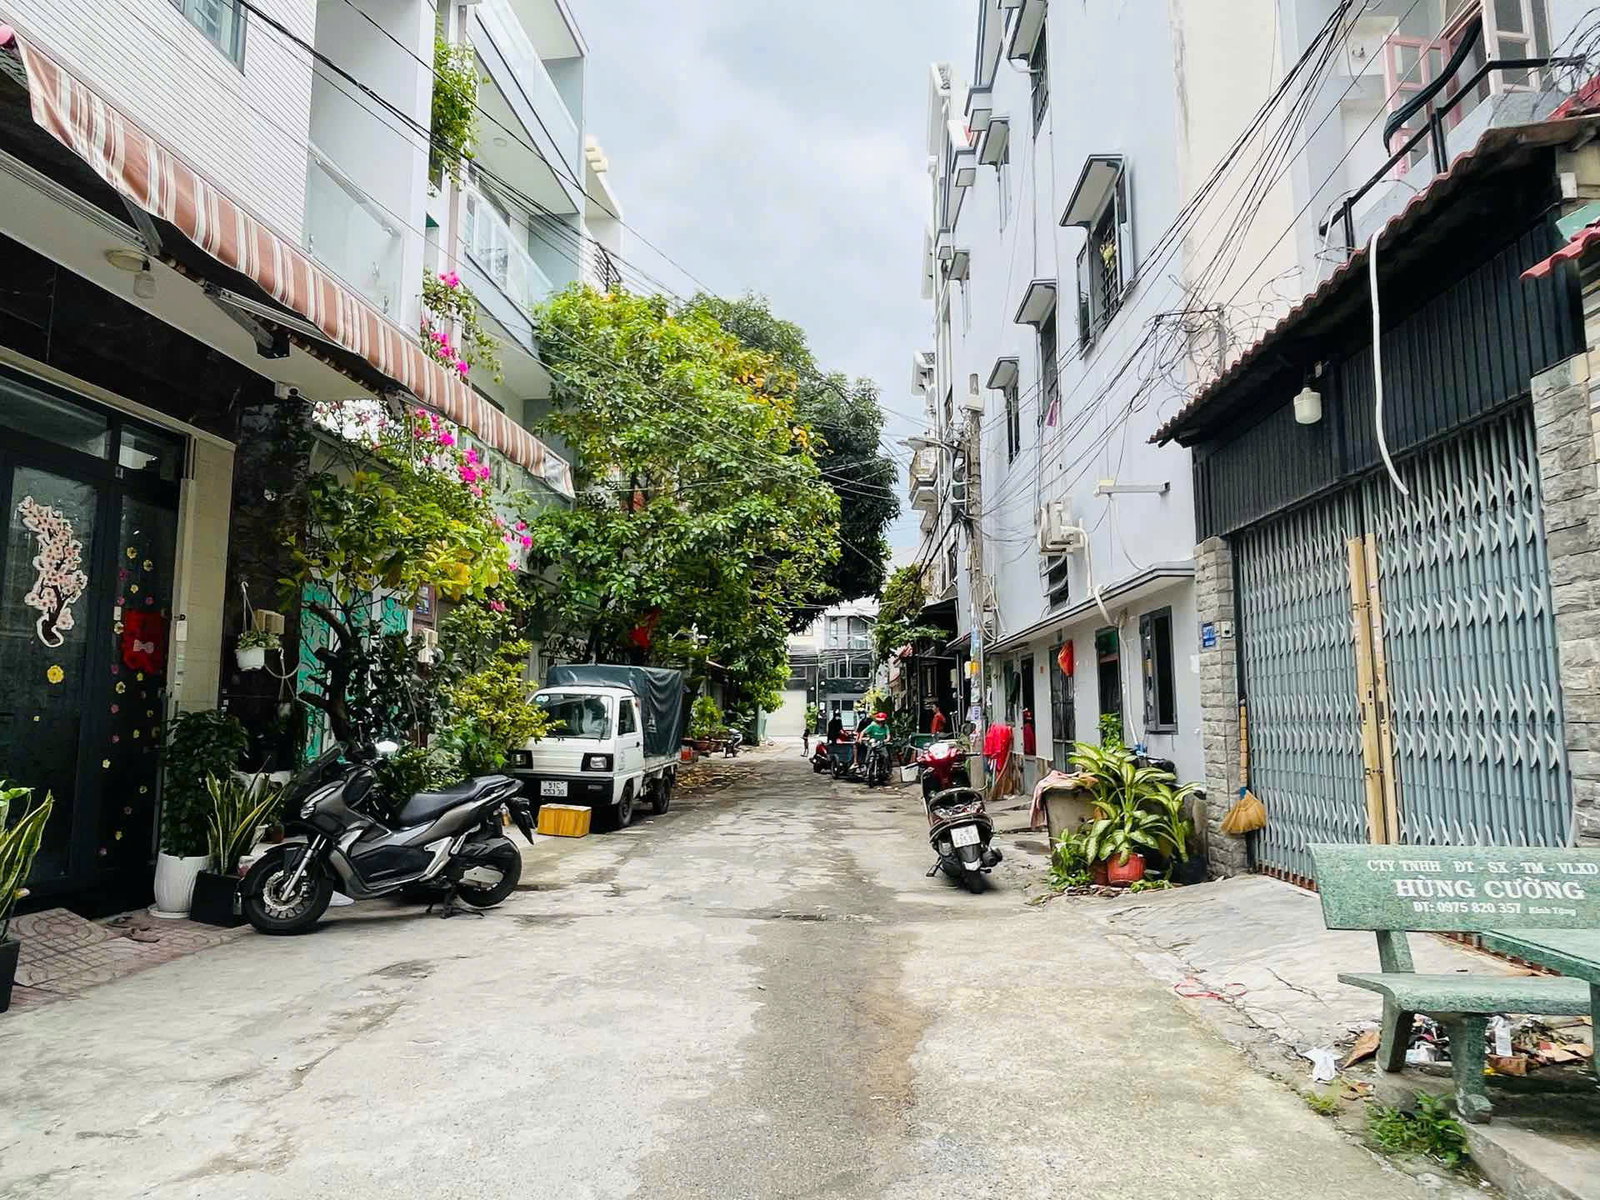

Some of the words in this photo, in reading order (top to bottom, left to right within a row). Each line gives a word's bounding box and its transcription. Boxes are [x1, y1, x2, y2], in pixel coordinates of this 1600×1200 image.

[1367, 859, 1395, 872] CTY
[1399, 860, 1442, 872] TNHH
[1487, 861, 1510, 873] SX
[1519, 862, 1547, 874] TM
[1556, 862, 1599, 875] VLXD
[1391, 874, 1476, 898] HÙNG
[1483, 876, 1586, 900] CƯỜNG
[1436, 901, 1469, 913] 0975
[1471, 902, 1496, 913] 820
[1497, 902, 1521, 914] 357
